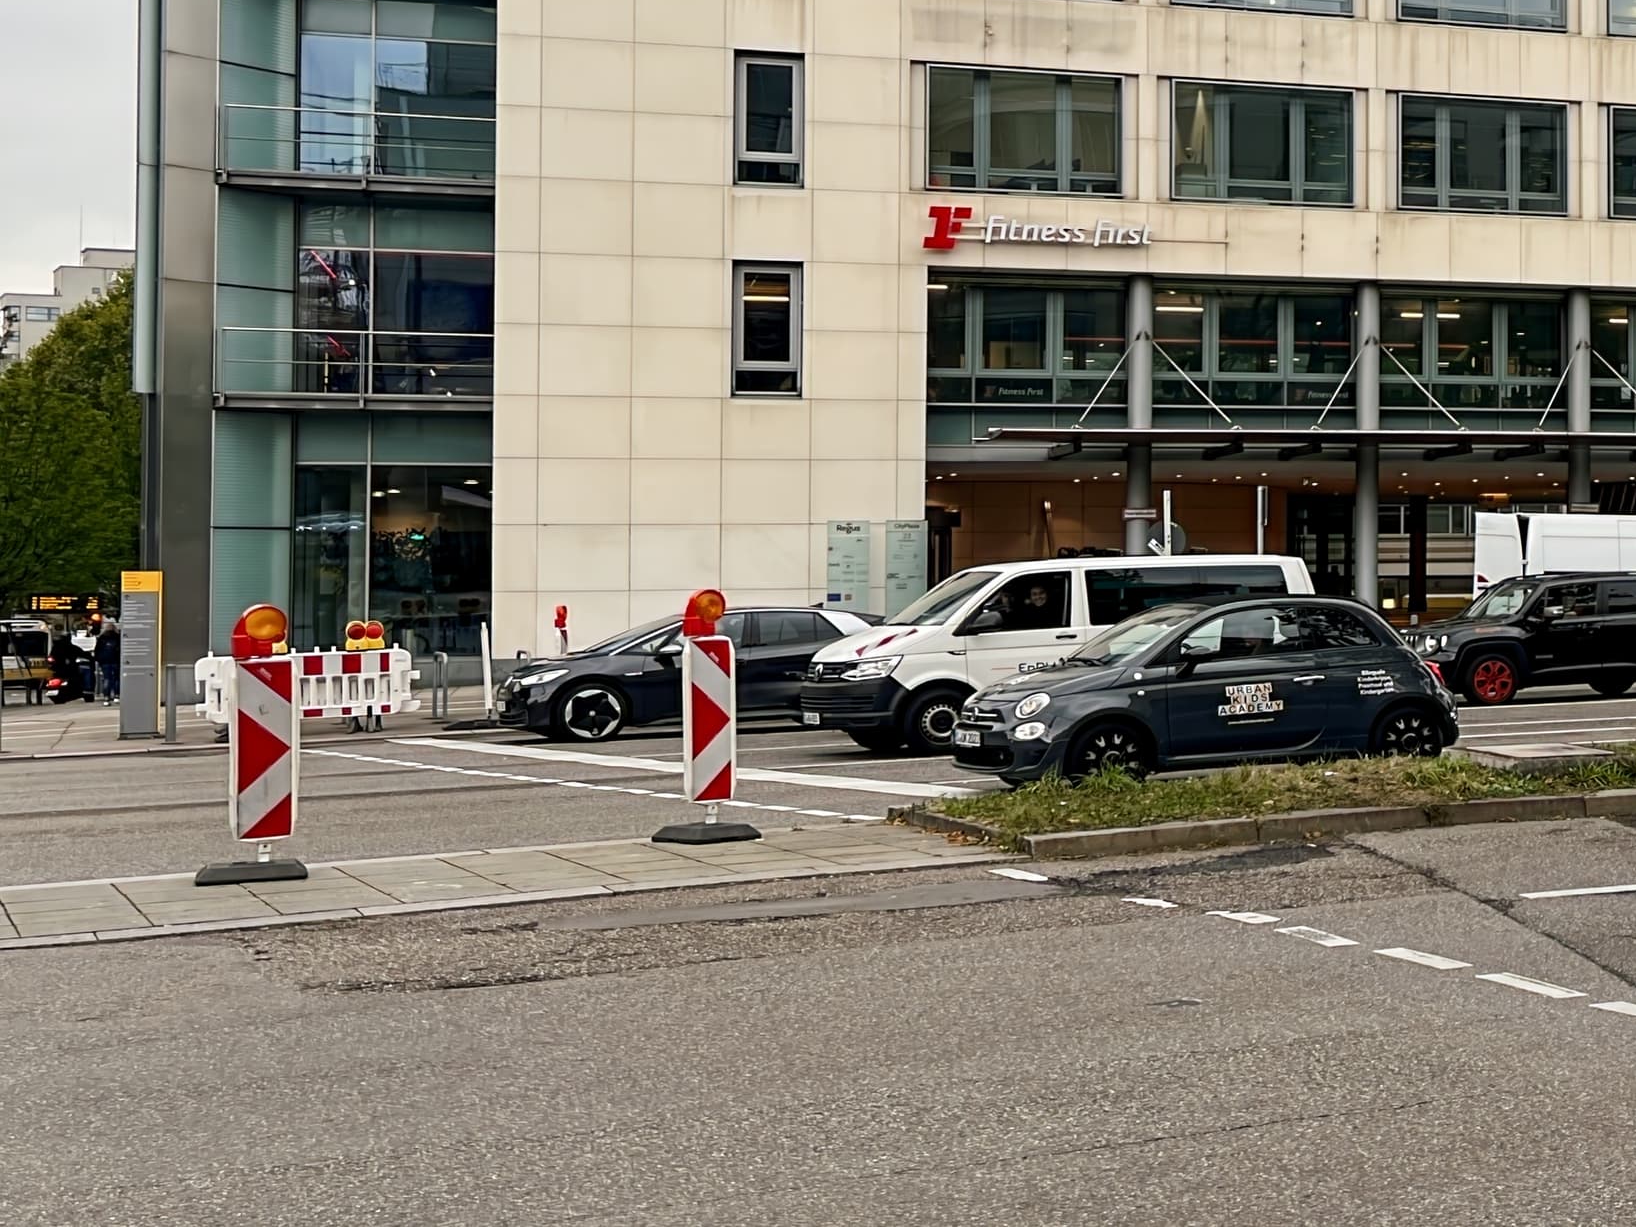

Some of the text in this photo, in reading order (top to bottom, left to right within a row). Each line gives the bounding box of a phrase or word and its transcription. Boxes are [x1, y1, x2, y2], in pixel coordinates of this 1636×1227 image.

[1227, 683, 1272, 696] URBAN
[1232, 692, 1268, 704] KIDS
[1219, 701, 1282, 716] ACADEMY
